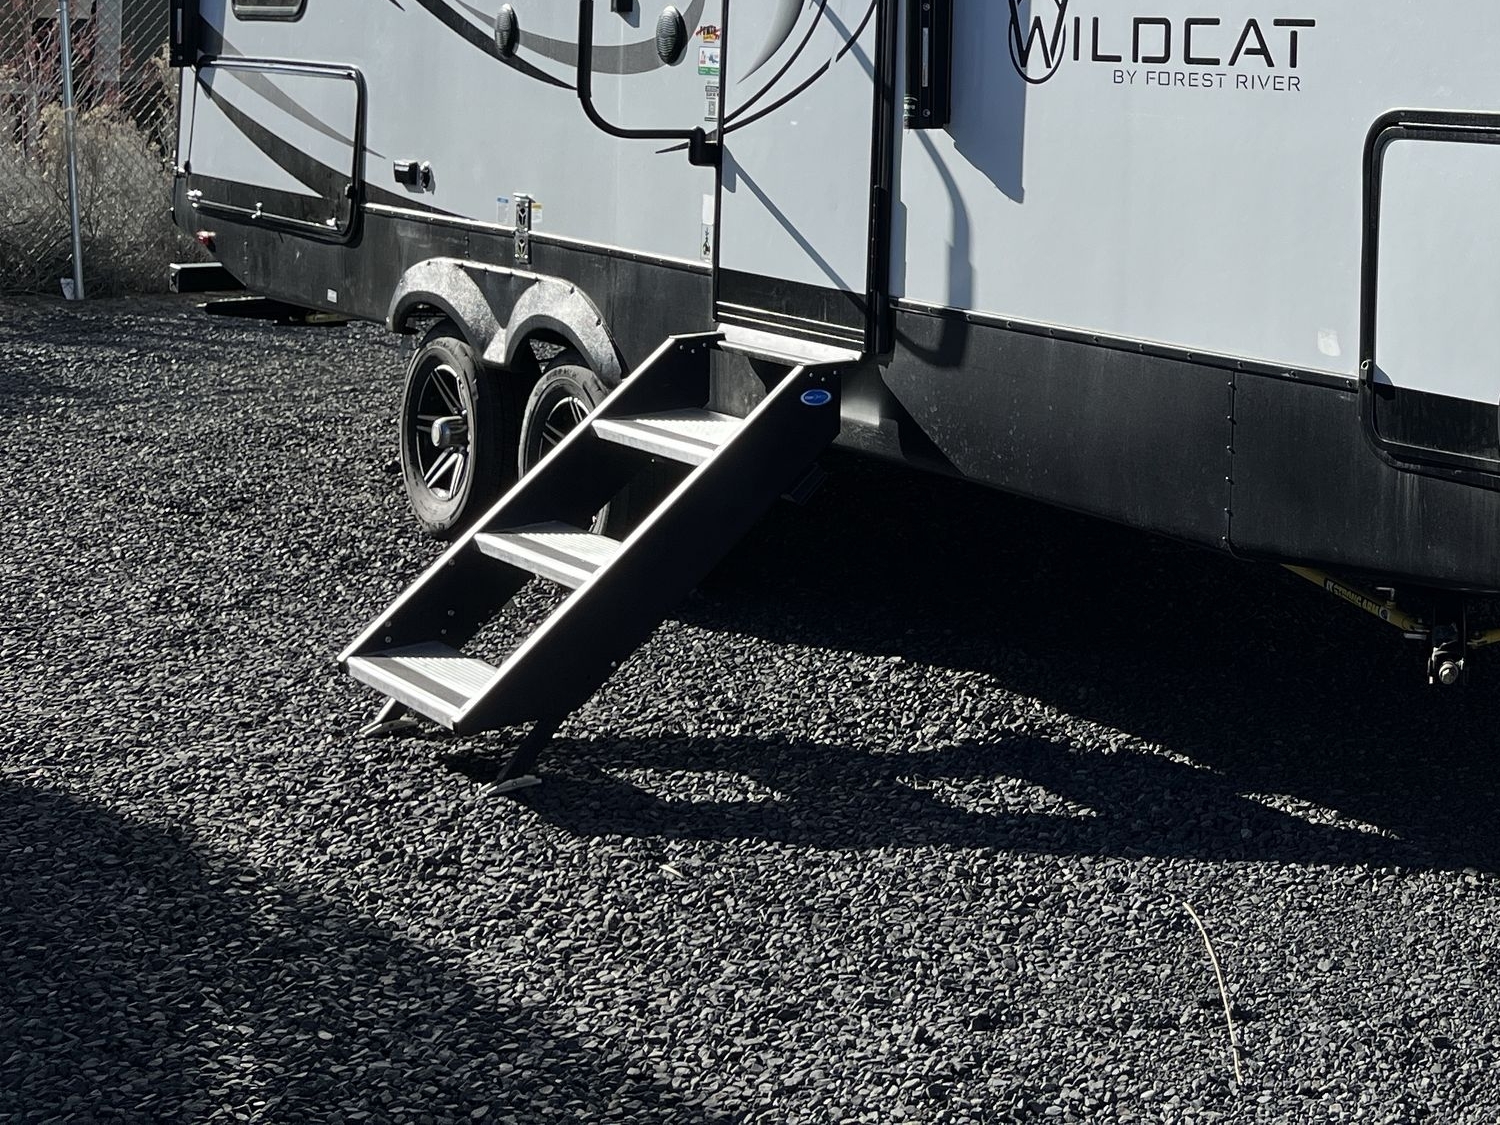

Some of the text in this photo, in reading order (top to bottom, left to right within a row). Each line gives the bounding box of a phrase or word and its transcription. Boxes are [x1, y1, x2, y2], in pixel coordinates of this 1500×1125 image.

[1113, 70, 1301, 91] BY FOREST RIVER
